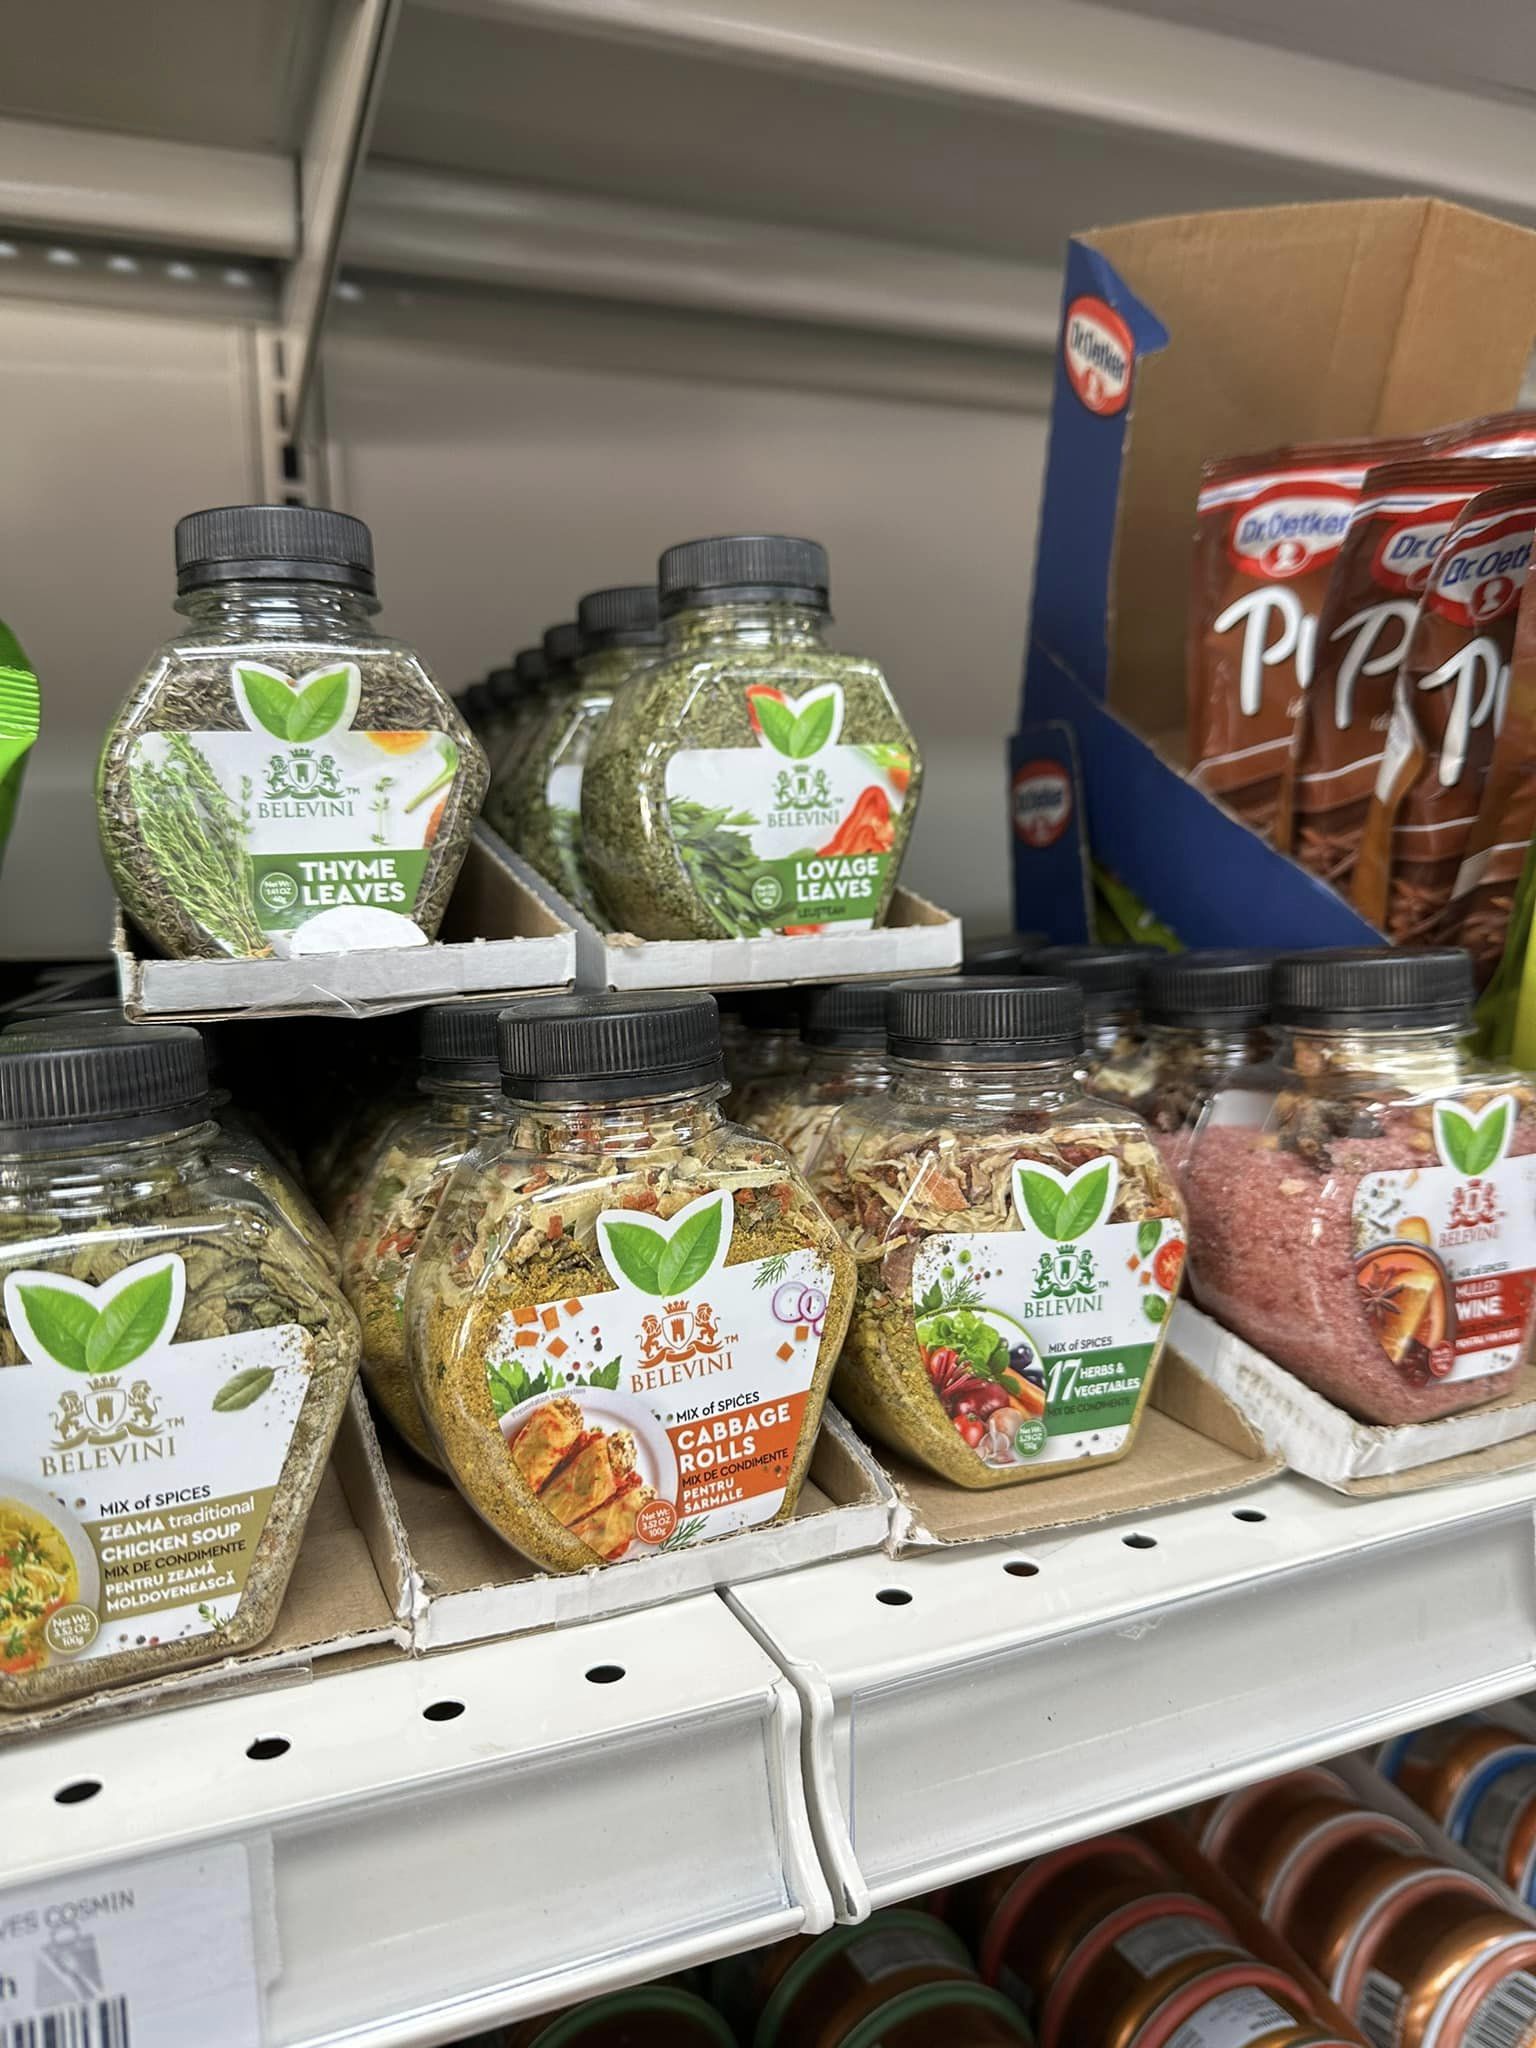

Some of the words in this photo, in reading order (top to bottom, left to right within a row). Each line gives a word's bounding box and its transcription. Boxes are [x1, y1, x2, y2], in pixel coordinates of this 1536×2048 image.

[256, 800, 354, 819] BELEVINI
[768, 809, 840, 829] BELEVINI
[298, 858, 397, 882] THYME
[795, 857, 879, 881] LOVAGE
[302, 881, 406, 906] LEAVES
[797, 878, 873, 903] LEAVES
[1023, 1294, 1103, 1320] BELEVINI
[1455, 1296, 1504, 1321] WINE
[1047, 1342, 1067, 1354] MIX
[1068, 1338, 1079, 1352] of
[1080, 1335, 1113, 1350] SPICES
[631, 1351, 734, 1394] BELEVINI
[1046, 1357, 1083, 1403] 17
[1080, 1362, 1115, 1380] HERBS
[1115, 1361, 1126, 1374] &
[1074, 1377, 1141, 1398] VEGETABLES
[676, 1407, 700, 1424] MIX
[702, 1401, 715, 1416] of
[717, 1391, 760, 1413] SPICES
[677, 1402, 791, 1450] CABBAGE
[40, 1436, 176, 1477] BELEVINI
[680, 1435, 756, 1474] ROLLS
[682, 1474, 702, 1489] MIX
[703, 1470, 719, 1483] DE
[720, 1447, 789, 1476] CONDIMENTE
[100, 1500, 130, 1517] MIX
[134, 1494, 152, 1511] of
[154, 1485, 212, 1507] SPICES
[682, 1477, 735, 1502] PENTRU
[684, 1487, 744, 1514] SARMALE
[100, 1517, 166, 1542] ZEAMA
[167, 1495, 256, 1529] traditional
[101, 1532, 189, 1562] CHICKEN
[191, 1521, 242, 1546] SOUP
[104, 1564, 130, 1580] MIX
[133, 1559, 153, 1575] DE
[154, 1539, 246, 1568] CONDIMENTE
[105, 1573, 165, 1598] PENTRU
[166, 1559, 217, 1585] ZEAMĂ
[106, 1570, 237, 1614] MOLDOVENEASCĂ
[44, 1889, 135, 1928] COSMIN
